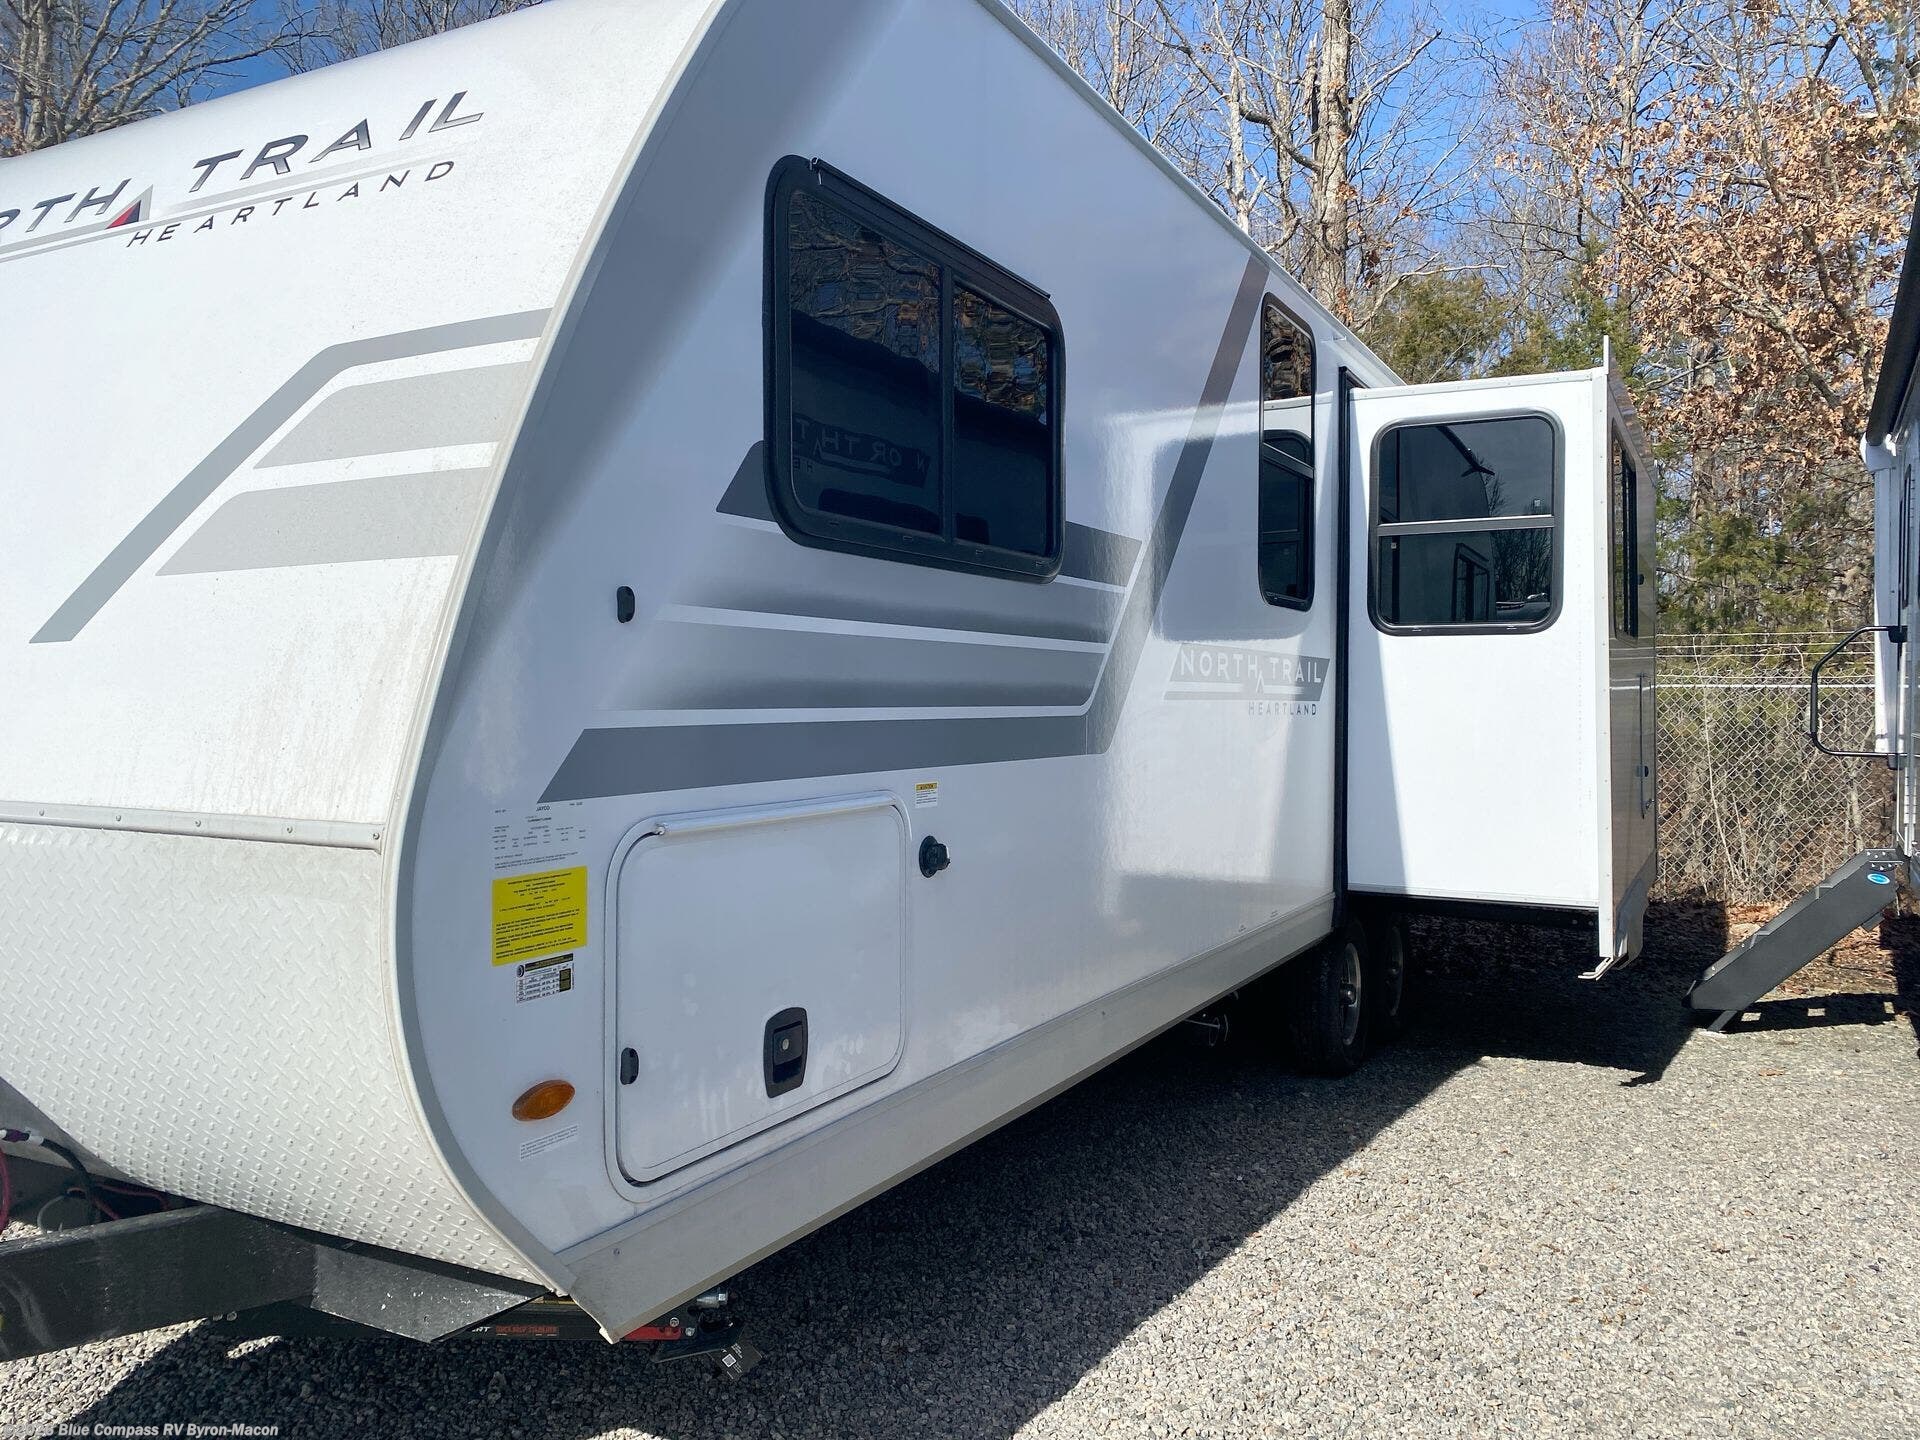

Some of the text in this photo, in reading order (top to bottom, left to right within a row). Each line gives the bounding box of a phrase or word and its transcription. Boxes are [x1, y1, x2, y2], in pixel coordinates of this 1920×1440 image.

[189, 90, 484, 192] TRAIL
[127, 160, 455, 248] HEARTLAND
[1180, 649, 1322, 684] NORTH TRAIL
[1249, 702, 1317, 716] HEARTLAND
